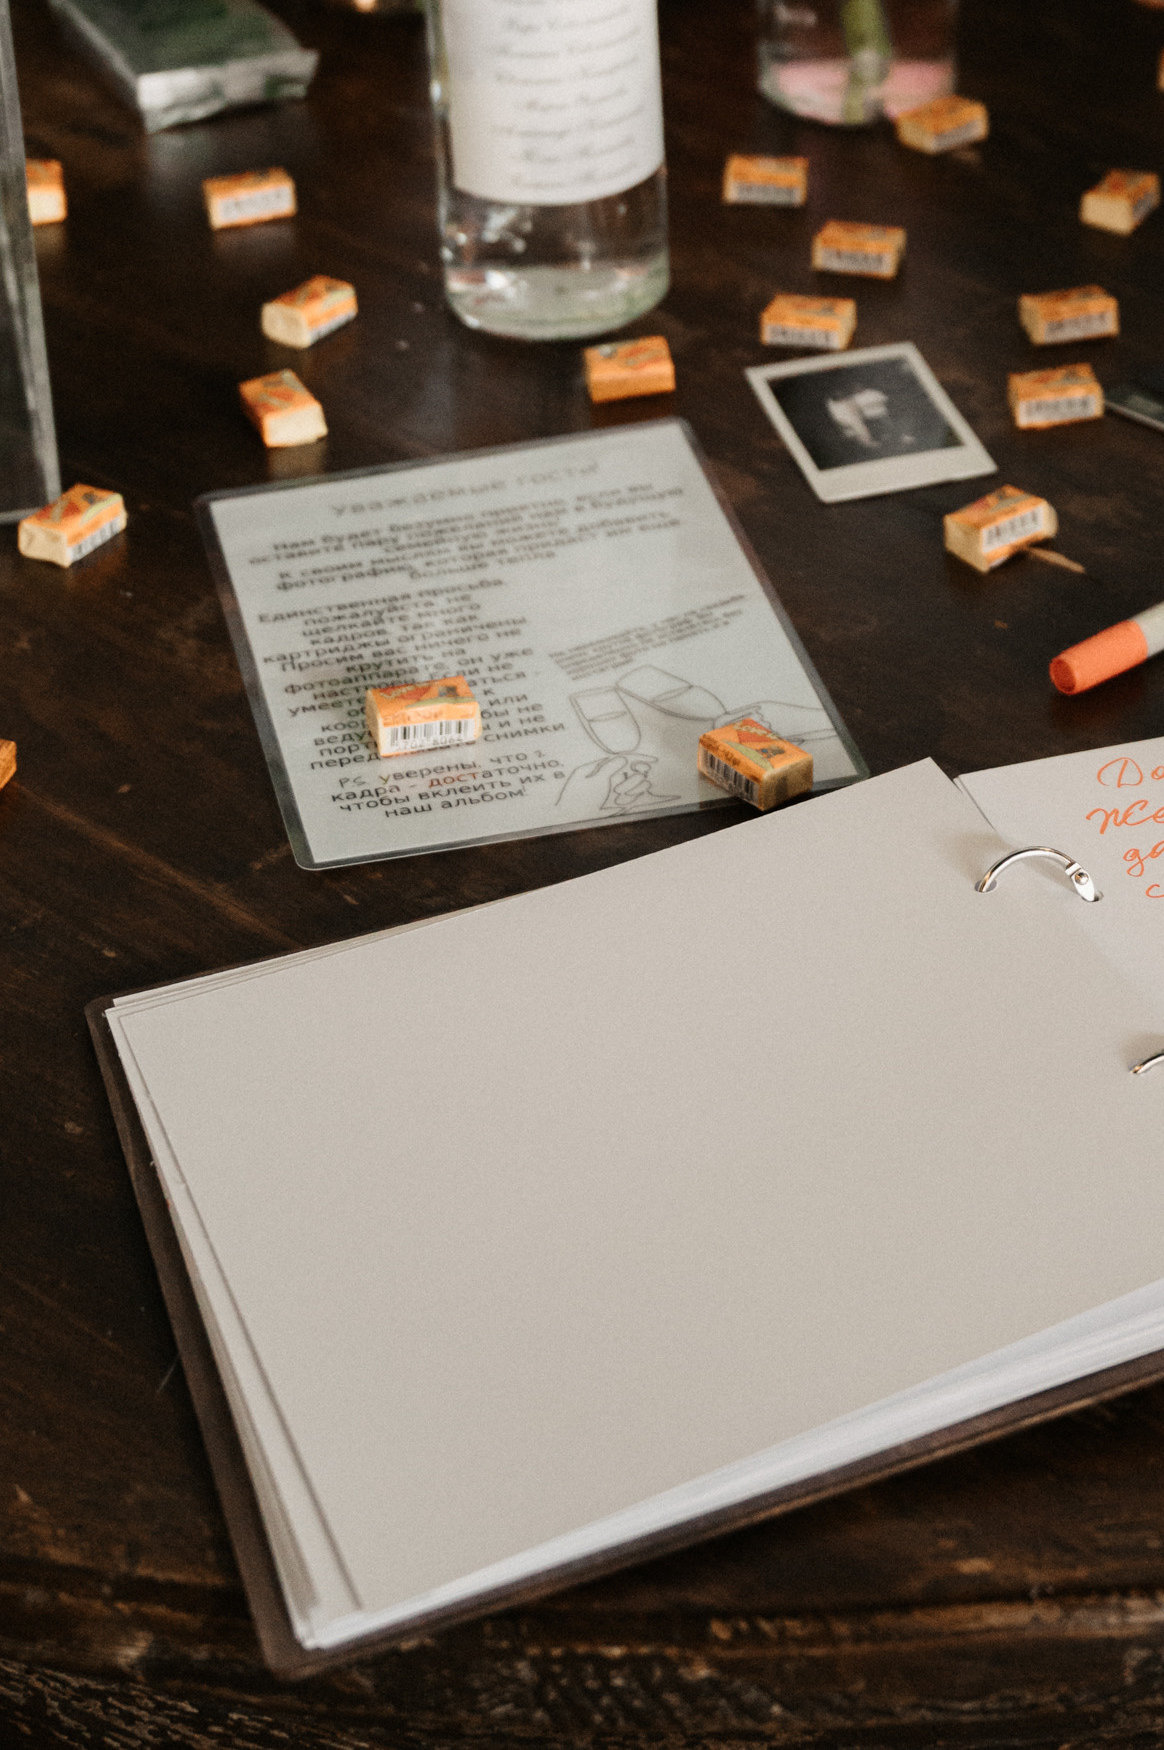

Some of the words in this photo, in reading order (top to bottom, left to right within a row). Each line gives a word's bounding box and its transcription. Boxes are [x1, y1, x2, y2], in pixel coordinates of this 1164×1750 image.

[329, 481, 502, 517] Уважаемые
[272, 539, 315, 551] Нам
[320, 528, 380, 544] будет
[257, 592, 411, 623] Единственная
[415, 601, 482, 619] много
[399, 621, 429, 632] так
[442, 613, 478, 625] как
[280, 648, 364, 672] Просим
[370, 647, 402, 659] вас
[413, 632, 490, 651] ничего
[489, 648, 532, 663] уже
[343, 653, 435, 677] крутить
[487, 693, 528, 707] или
[482, 722, 564, 742] снимки
[488, 752, 528, 765] что
[330, 784, 400, 802] кадра
[338, 794, 410, 812] чтобы
[417, 780, 511, 801] вклеить
[383, 803, 433, 818] наш
[439, 788, 524, 810] альбом!
